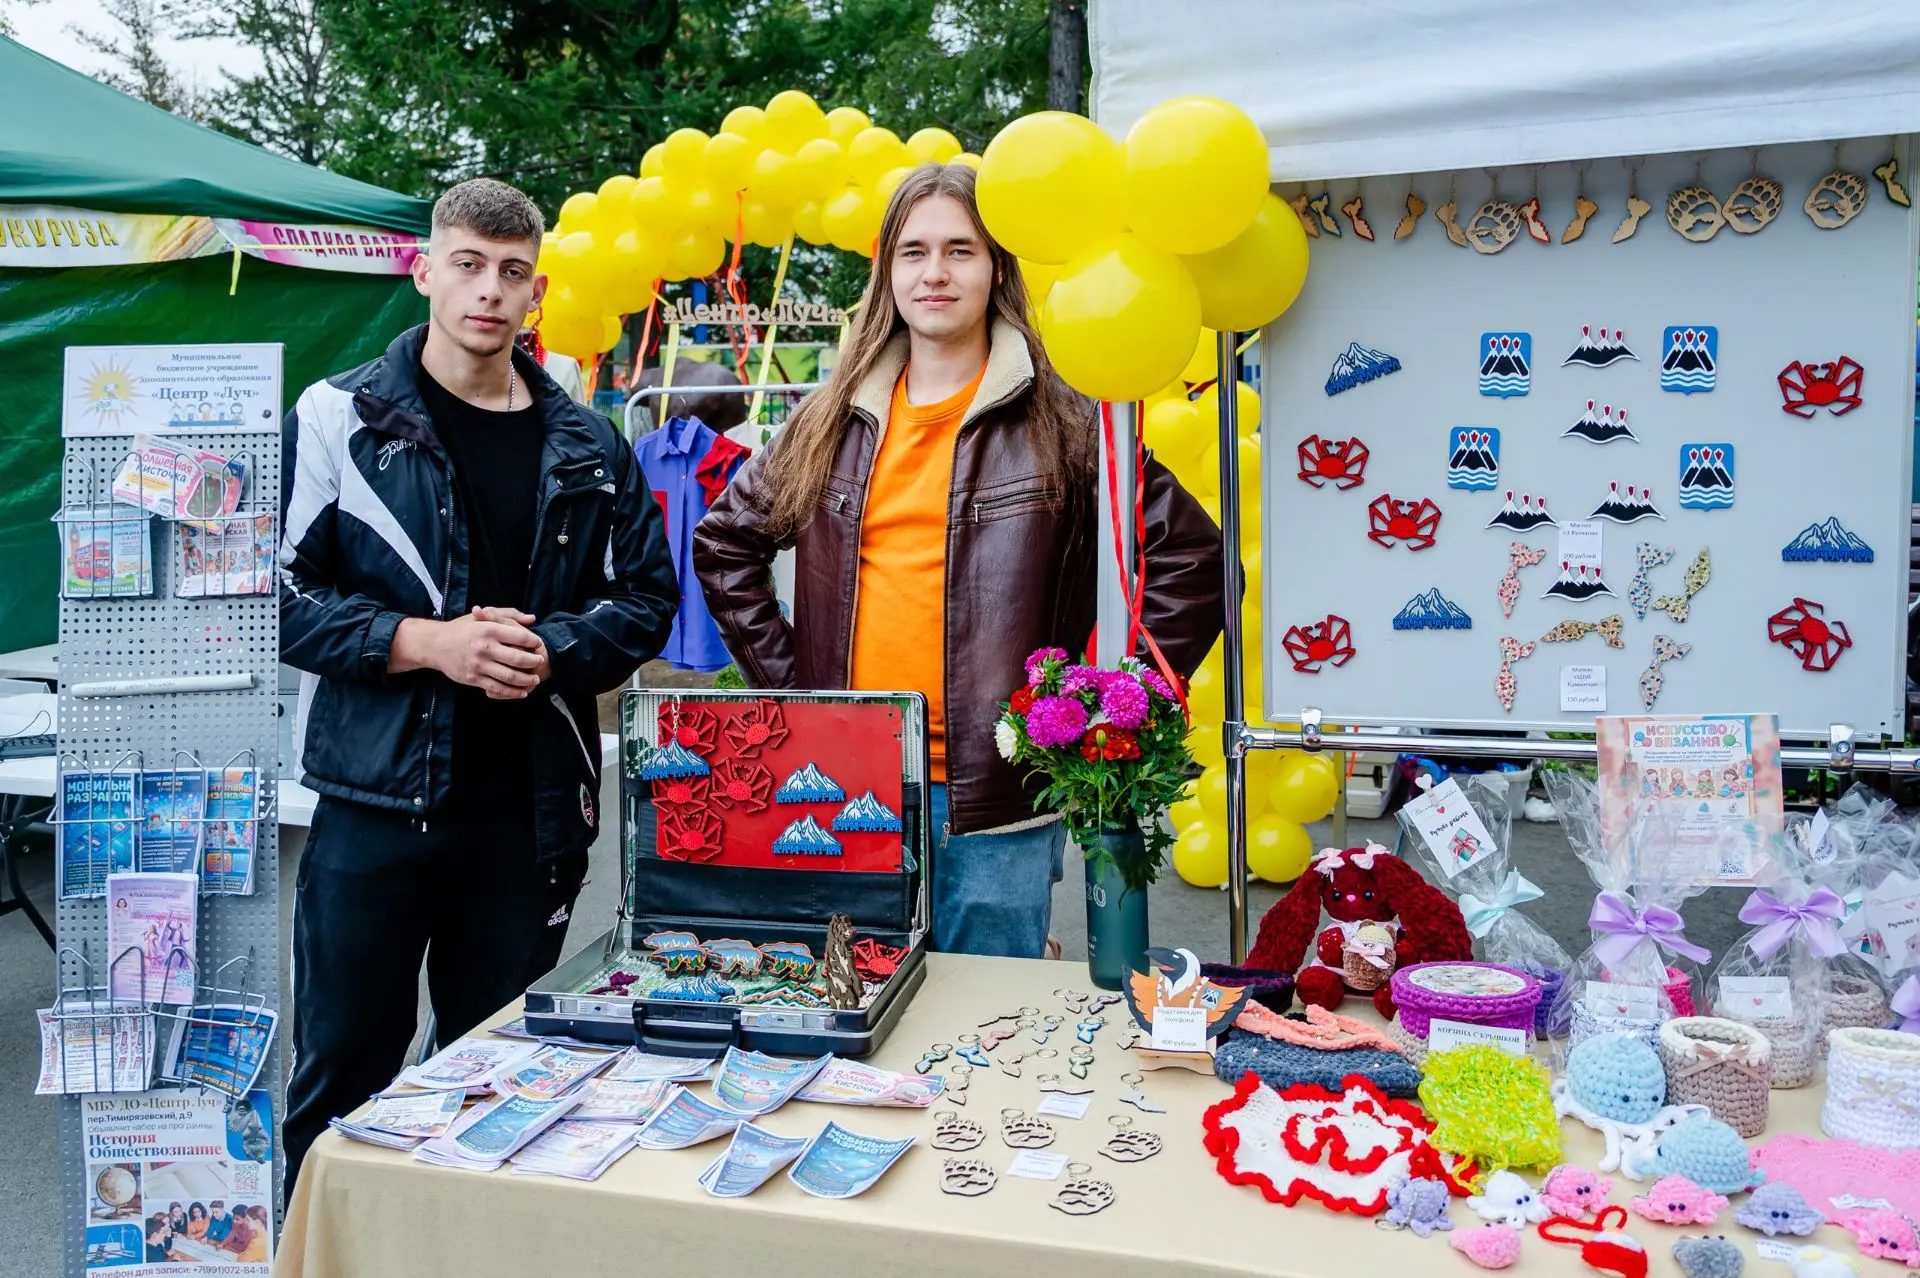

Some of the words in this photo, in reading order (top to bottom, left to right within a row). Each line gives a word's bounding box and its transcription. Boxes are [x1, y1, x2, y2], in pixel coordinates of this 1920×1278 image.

[360, 234, 404, 259] ВАТА
[171, 353, 242, 362] Муниципальное
[156, 364, 205, 373] бюджетное
[206, 364, 259, 373] учреждение
[139, 375, 215, 384] дополнительного
[216, 374, 272, 383] образования
[151, 387, 209, 402] «Центр
[213, 386, 260, 401] «Луч»
[1646, 723, 1728, 736] ИСКУССТВО
[1655, 736, 1721, 748] ВЯЗАНИЯ
[547, 912, 569, 927] adidas
[1437, 1025, 1472, 1038] КОРЗИНА
[1480, 1032, 1521, 1044] КРЫШКОЙ
[87, 1101, 117, 1112] МБУ
[120, 1099, 140, 1111] ДО
[142, 1098, 190, 1110] «Центр
[88, 1124, 131, 1134] Объявляет
[132, 1122, 157, 1132] набор
[89, 1133, 156, 1147] История
[89, 1144, 222, 1159] Обществознание
[135, 1268, 154, 1278] для
[155, 1266, 192, 1275] записи:
